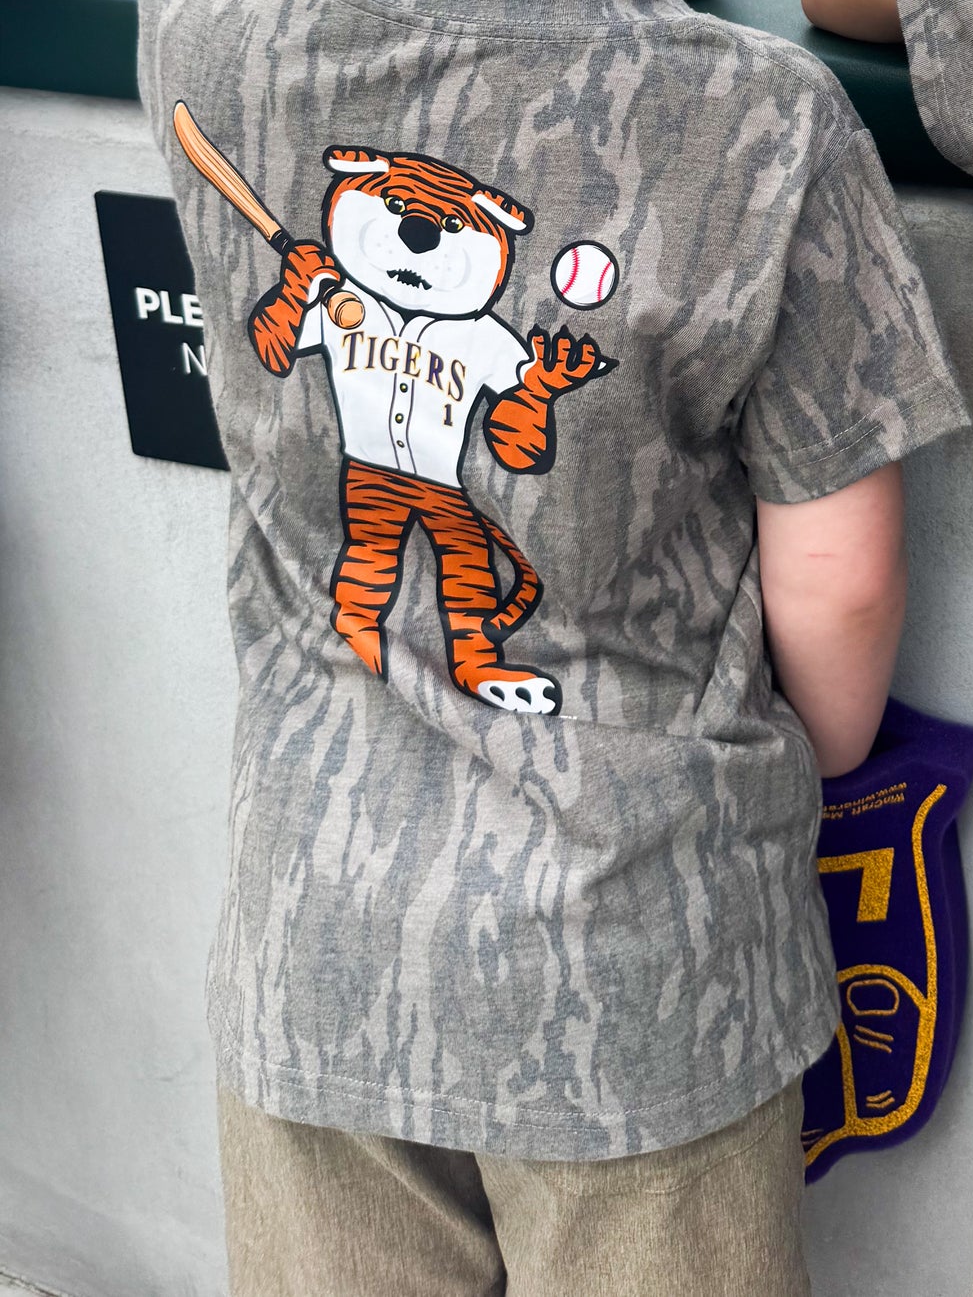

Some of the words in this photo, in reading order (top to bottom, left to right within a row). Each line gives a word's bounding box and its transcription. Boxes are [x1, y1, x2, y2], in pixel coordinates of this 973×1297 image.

[134, 287, 204, 327] PLE
[341, 330, 467, 402] TIGERS
[442, 402, 453, 427] 1
[851, 792, 905, 816] WinCraft
